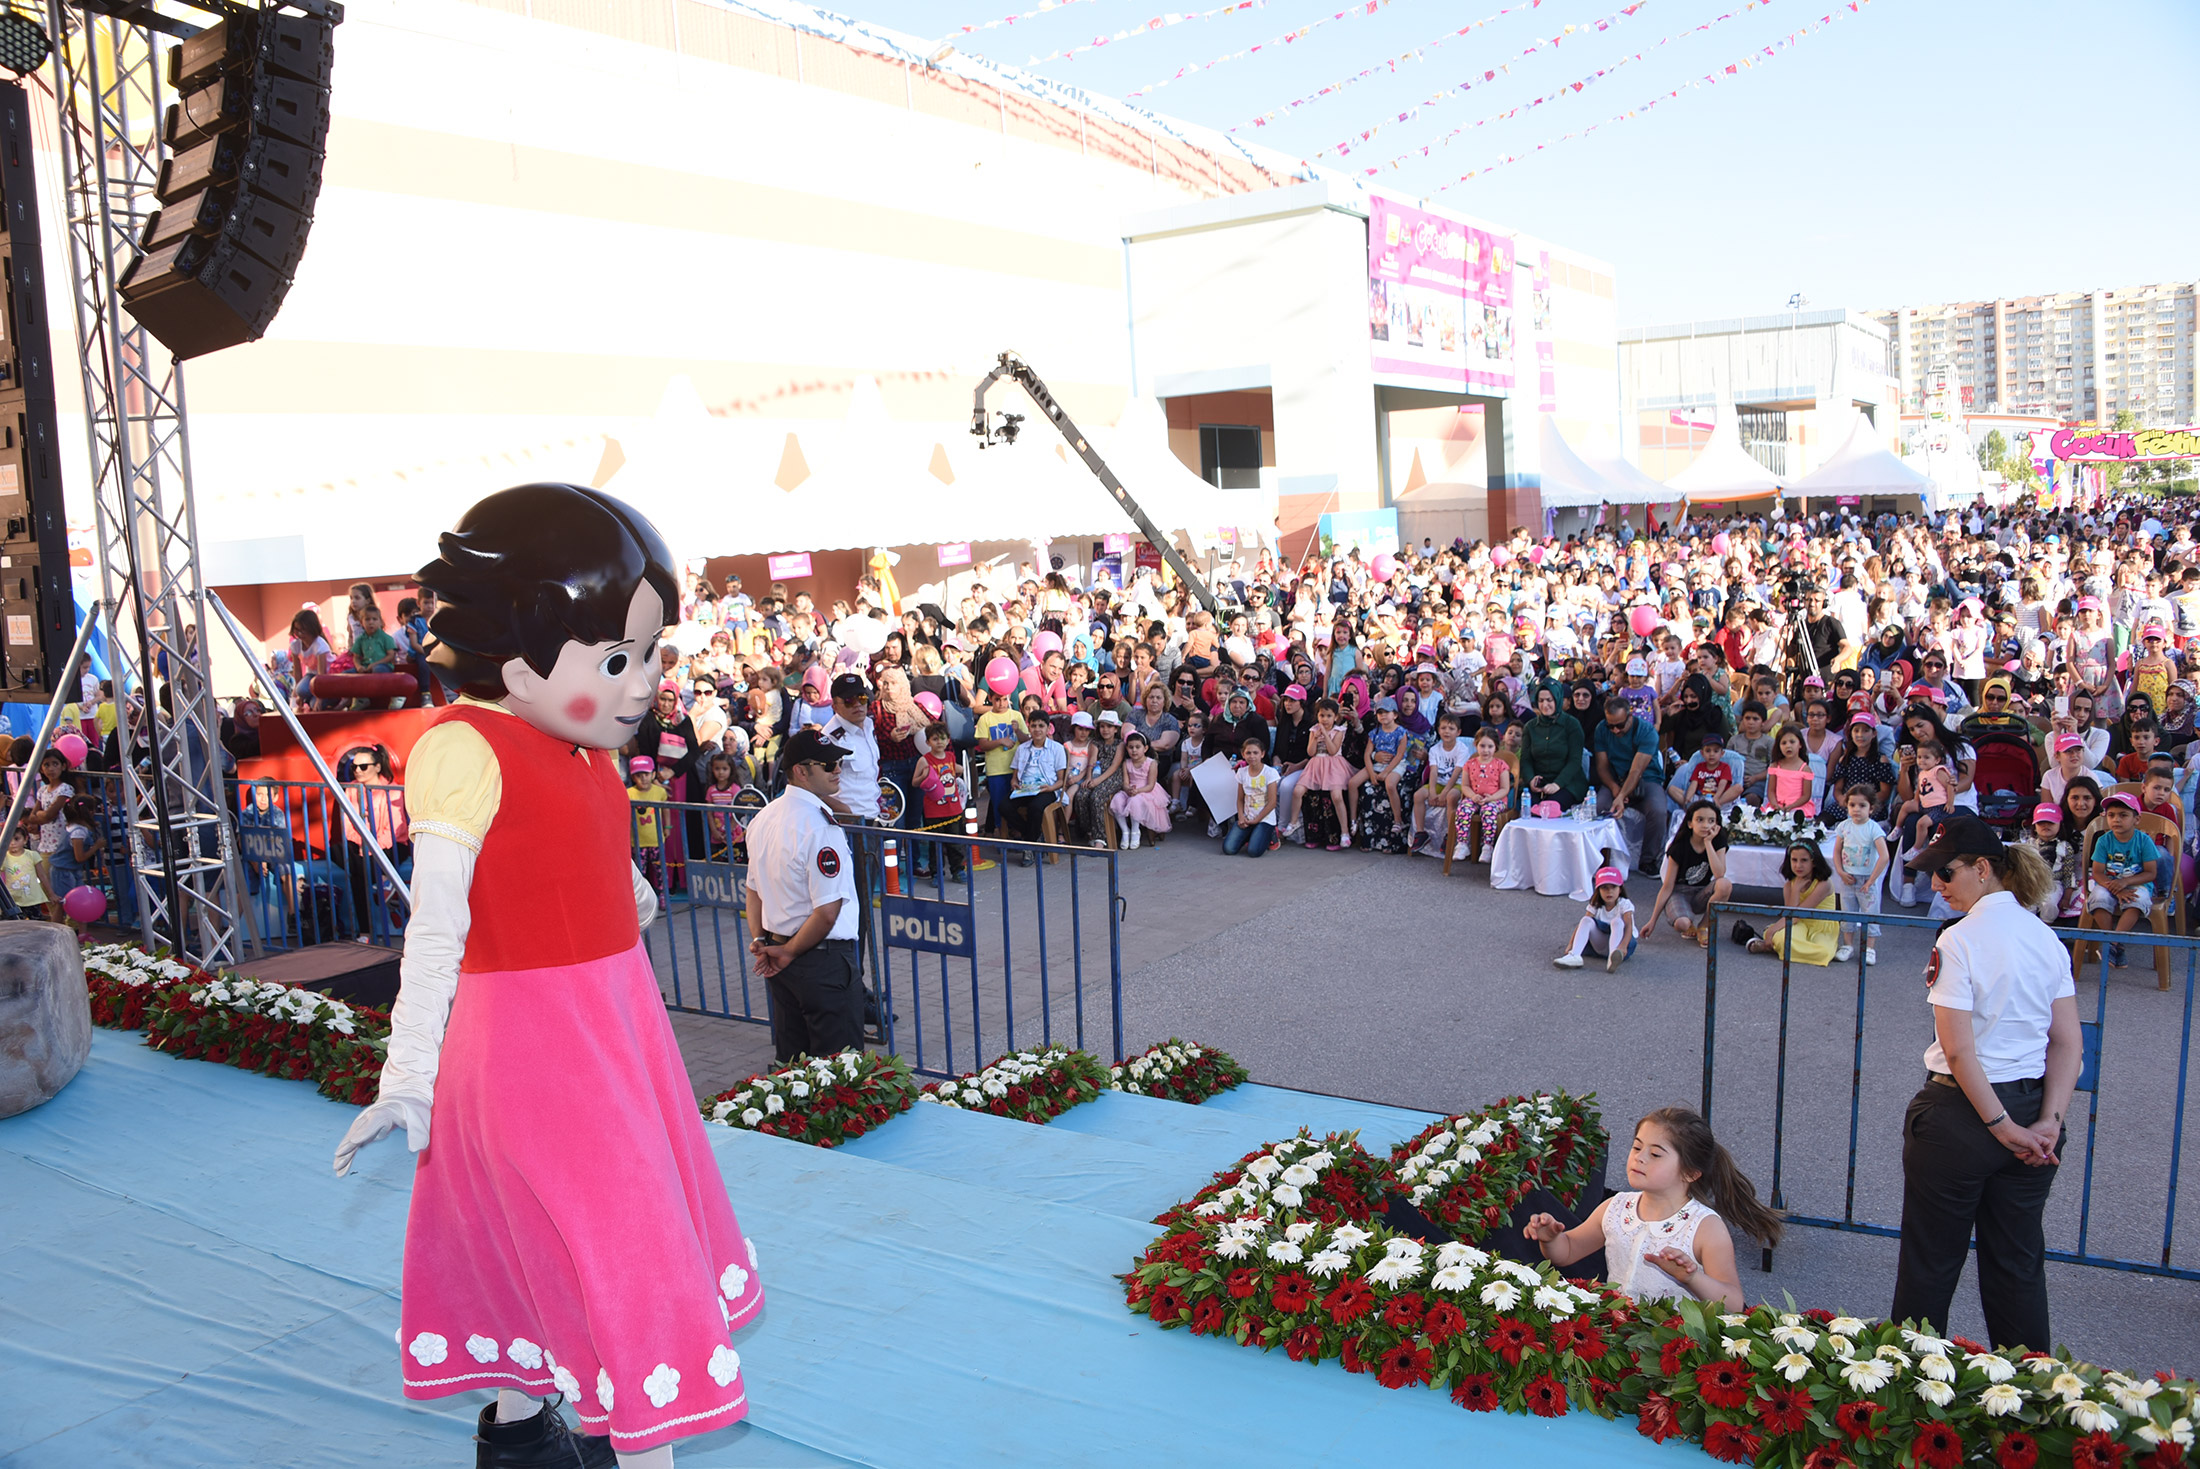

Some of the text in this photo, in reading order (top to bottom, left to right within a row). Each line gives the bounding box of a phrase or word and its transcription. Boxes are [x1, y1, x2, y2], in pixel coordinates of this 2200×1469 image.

[2051, 429, 2137, 460] Çocuk
[2073, 429, 2102, 439] Konya
[245, 831, 285, 857] POLİS
[692, 872, 747, 904] POLİS
[890, 914, 963, 945] POLİS
